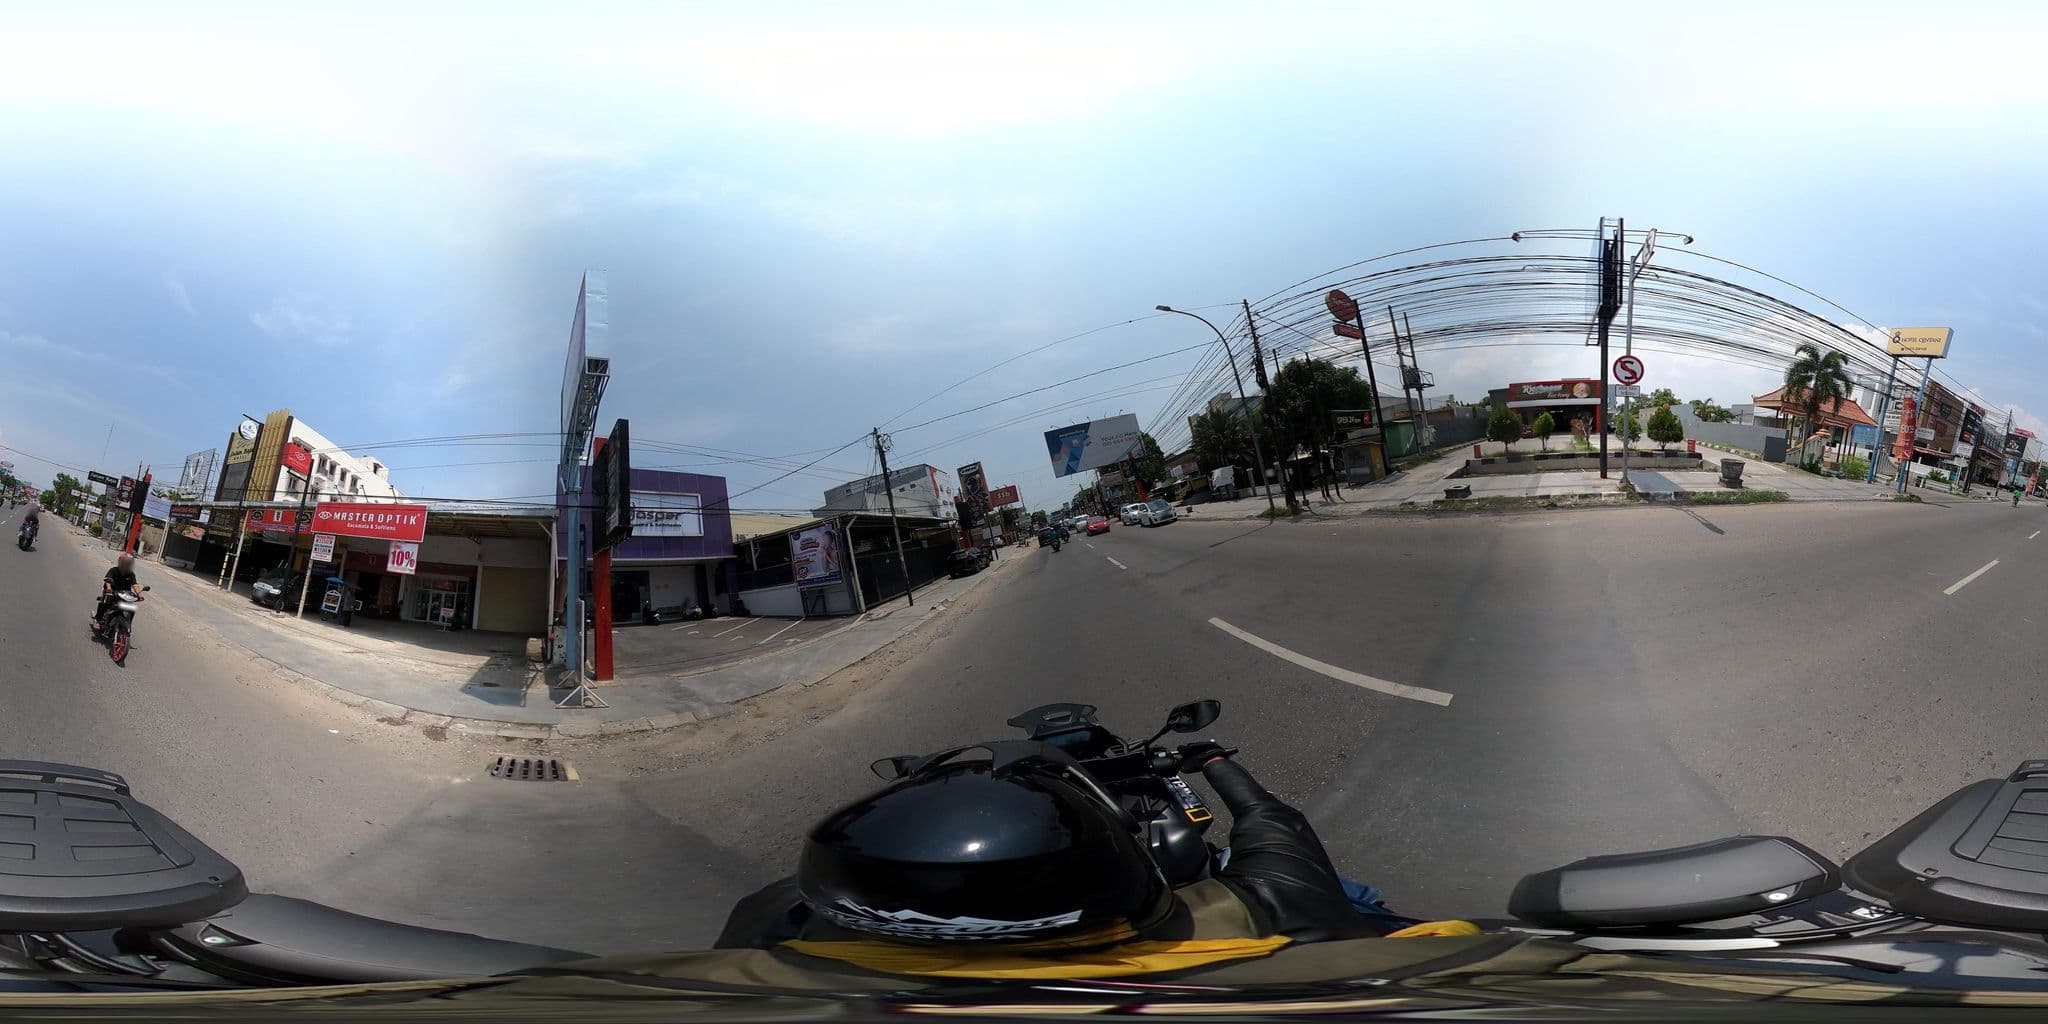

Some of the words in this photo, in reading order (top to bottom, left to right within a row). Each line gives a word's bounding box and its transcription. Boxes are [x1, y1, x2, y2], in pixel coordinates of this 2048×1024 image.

[333, 512, 374, 521] MASTER
[378, 513, 417, 525] OPTIK
[391, 550, 416, 568] 10%
